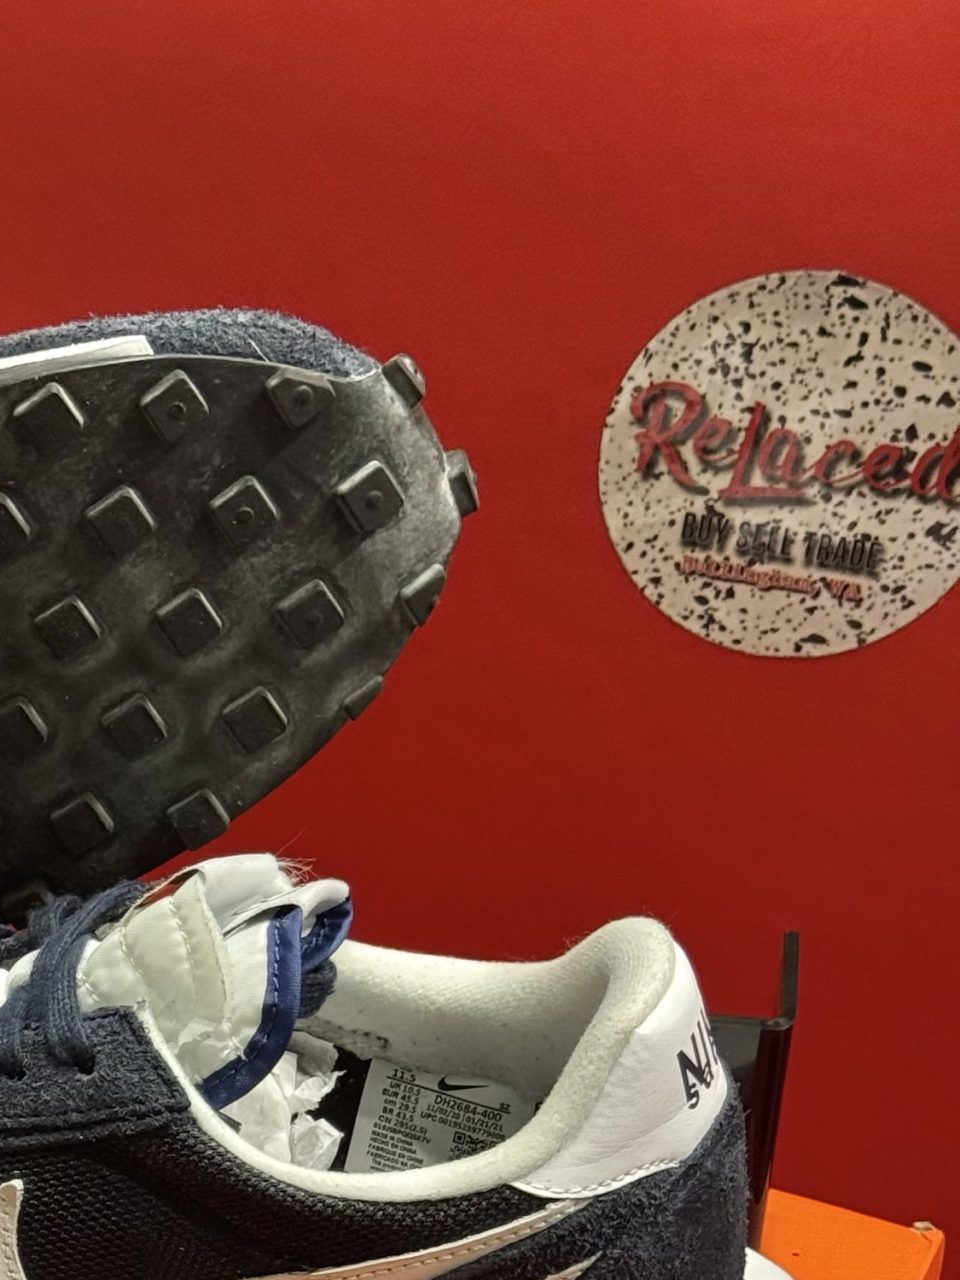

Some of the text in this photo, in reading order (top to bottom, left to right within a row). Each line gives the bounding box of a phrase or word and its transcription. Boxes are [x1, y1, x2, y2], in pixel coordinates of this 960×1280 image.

[682, 513, 884, 575] BUY SELL TRADE
[393, 1070, 416, 1082] 11.5
[382, 1088, 399, 1100] EUR
[389, 1082, 421, 1096] UK 10.5
[434, 1095, 503, 1122] DH2684-400
[378, 1115, 392, 1124] CN
[420, 1111, 437, 1121] UPC
